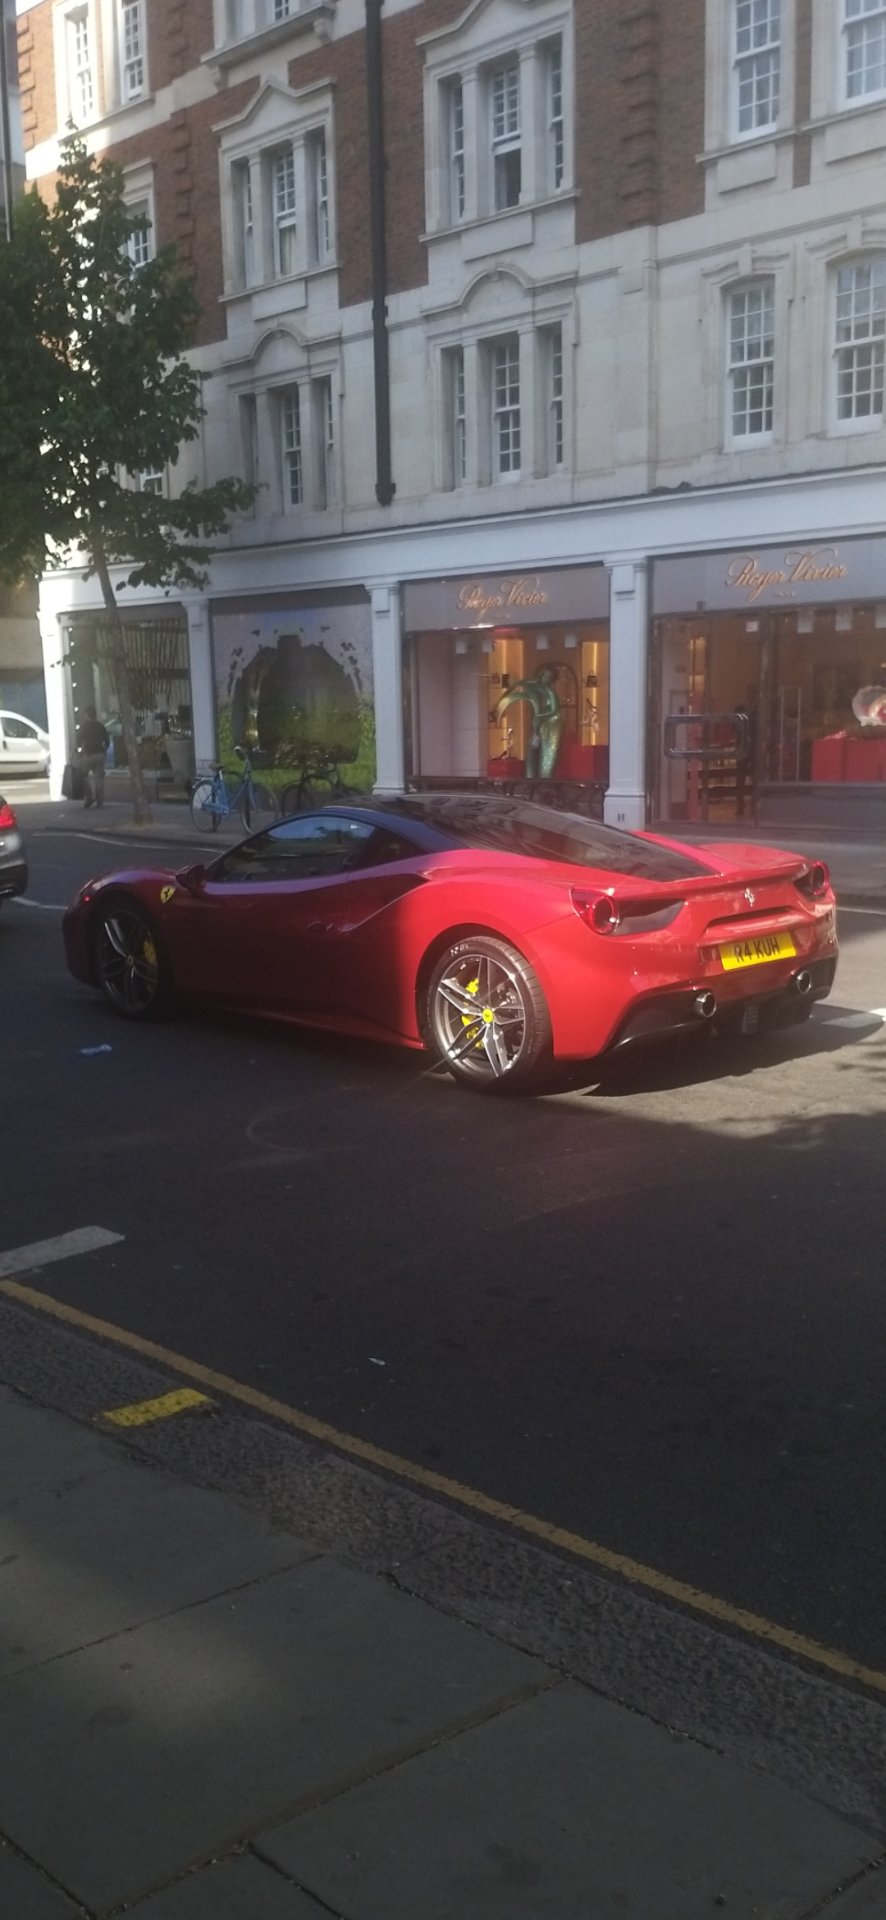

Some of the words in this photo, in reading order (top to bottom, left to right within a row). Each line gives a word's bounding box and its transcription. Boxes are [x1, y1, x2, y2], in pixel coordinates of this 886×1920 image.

[724, 556, 786, 602] Roger
[785, 547, 849, 583] Vivier
[733, 941, 753, 963] R4
[753, 936, 781, 959] KUH
